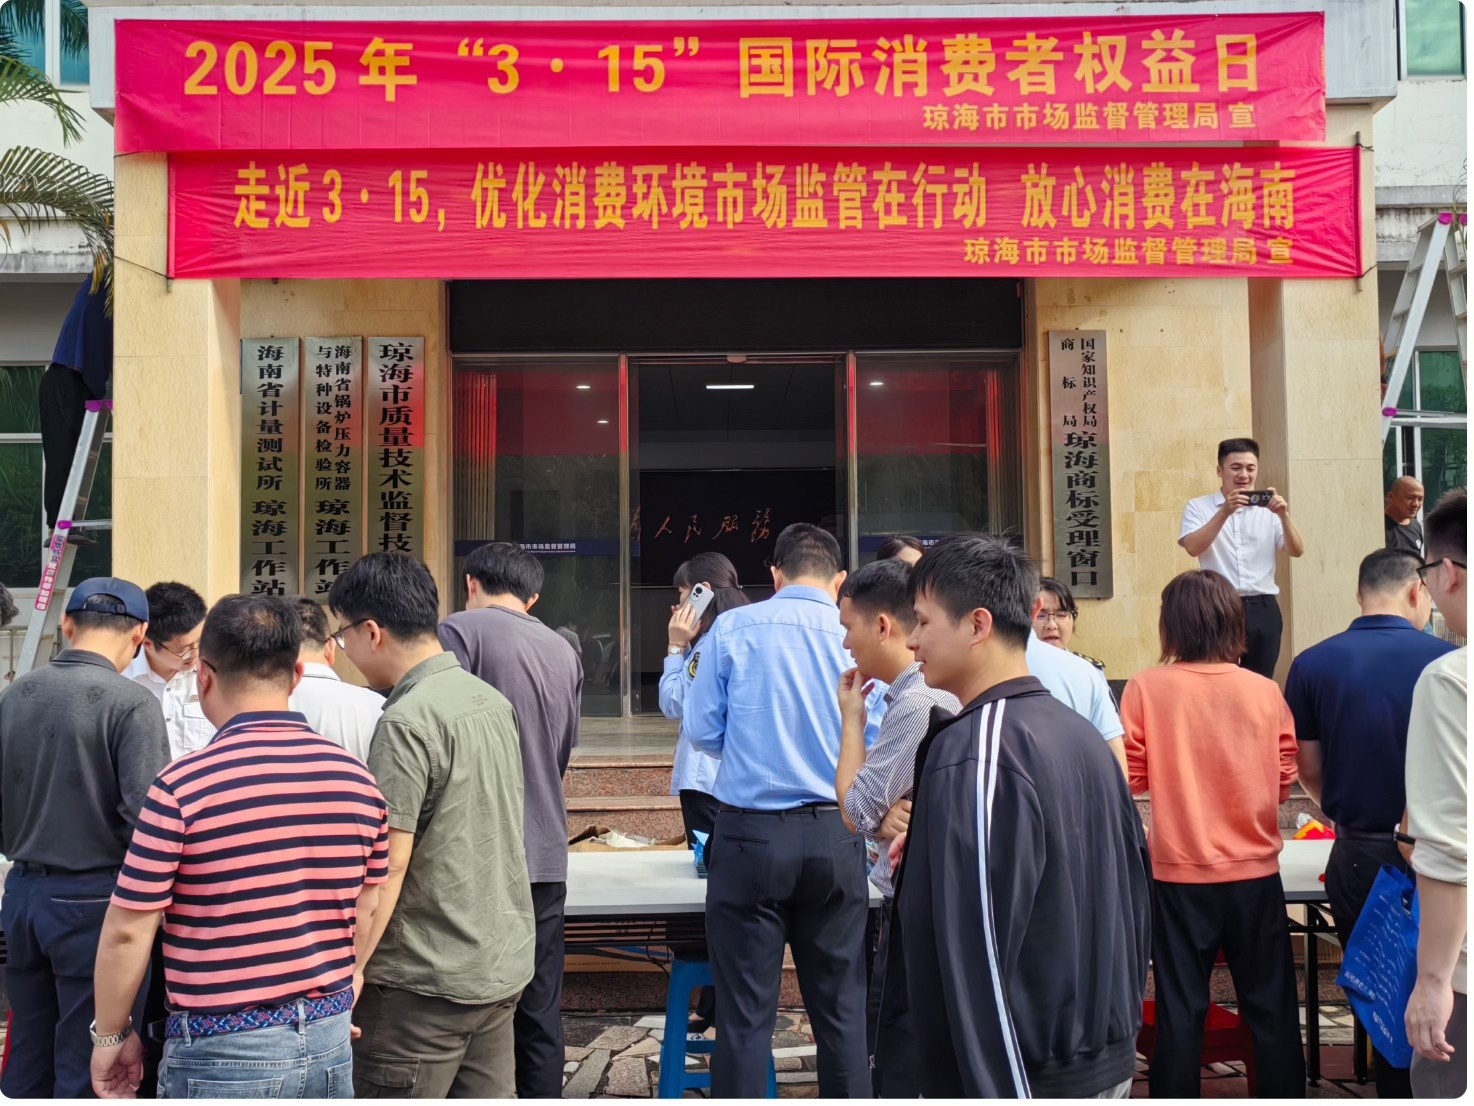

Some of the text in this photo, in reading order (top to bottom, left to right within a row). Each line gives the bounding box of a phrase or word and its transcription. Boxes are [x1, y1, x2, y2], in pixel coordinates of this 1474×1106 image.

[738, 28, 1260, 99] 国际消费者权益日
[922, 101, 1220, 131] 琼海市市场监督管理局
[1020, 160, 1297, 230] 放心消费在海南
[963, 235, 1257, 267] 琼海市市场监督管理局
[256, 345, 284, 491] 海南省计量测试所
[1063, 430, 1101, 587] 琼海商标受理窗口
